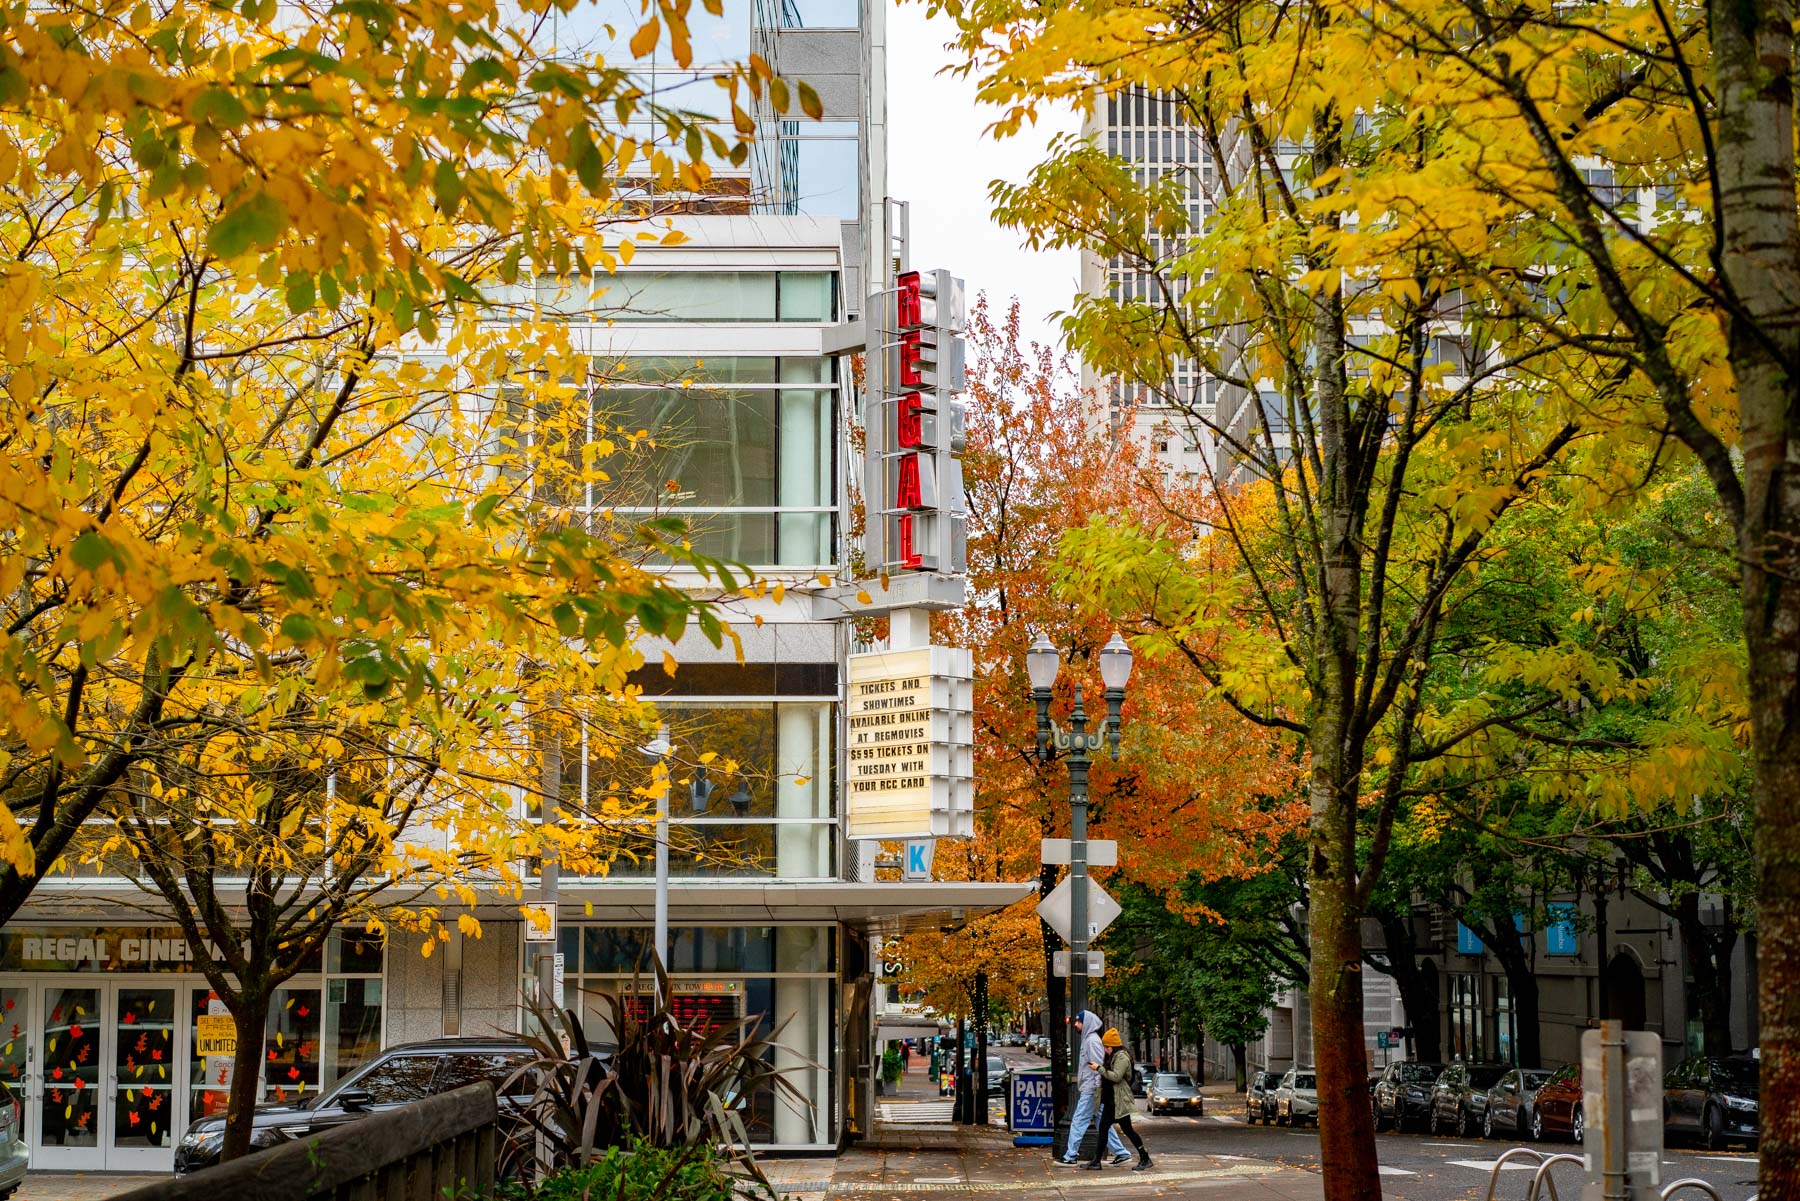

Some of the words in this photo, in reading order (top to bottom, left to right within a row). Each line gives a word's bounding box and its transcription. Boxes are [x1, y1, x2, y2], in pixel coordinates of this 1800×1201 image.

[897, 271, 922, 568] REGAL
[860, 681, 896, 695] TICKETS
[902, 678, 920, 690] AND
[863, 695, 915, 710] SHOWTIMES
[850, 714, 896, 729] AVAILABLE
[899, 710, 930, 724] ONLINE
[857, 732, 868, 743] AT
[874, 727, 924, 742] REGMOVIES
[877, 745, 912, 758] TICKETS
[917, 744, 929, 754] ON
[857, 761, 896, 775] TUESDAY
[901, 761, 924, 772] WITH
[853, 779, 876, 792] YOUR
[880, 778, 898, 790] RCC
[901, 777, 924, 789] CARD
[910, 845, 926, 872] K
[22, 938, 110, 960] REGAL
[199, 1038, 237, 1052] UNLIMITED
